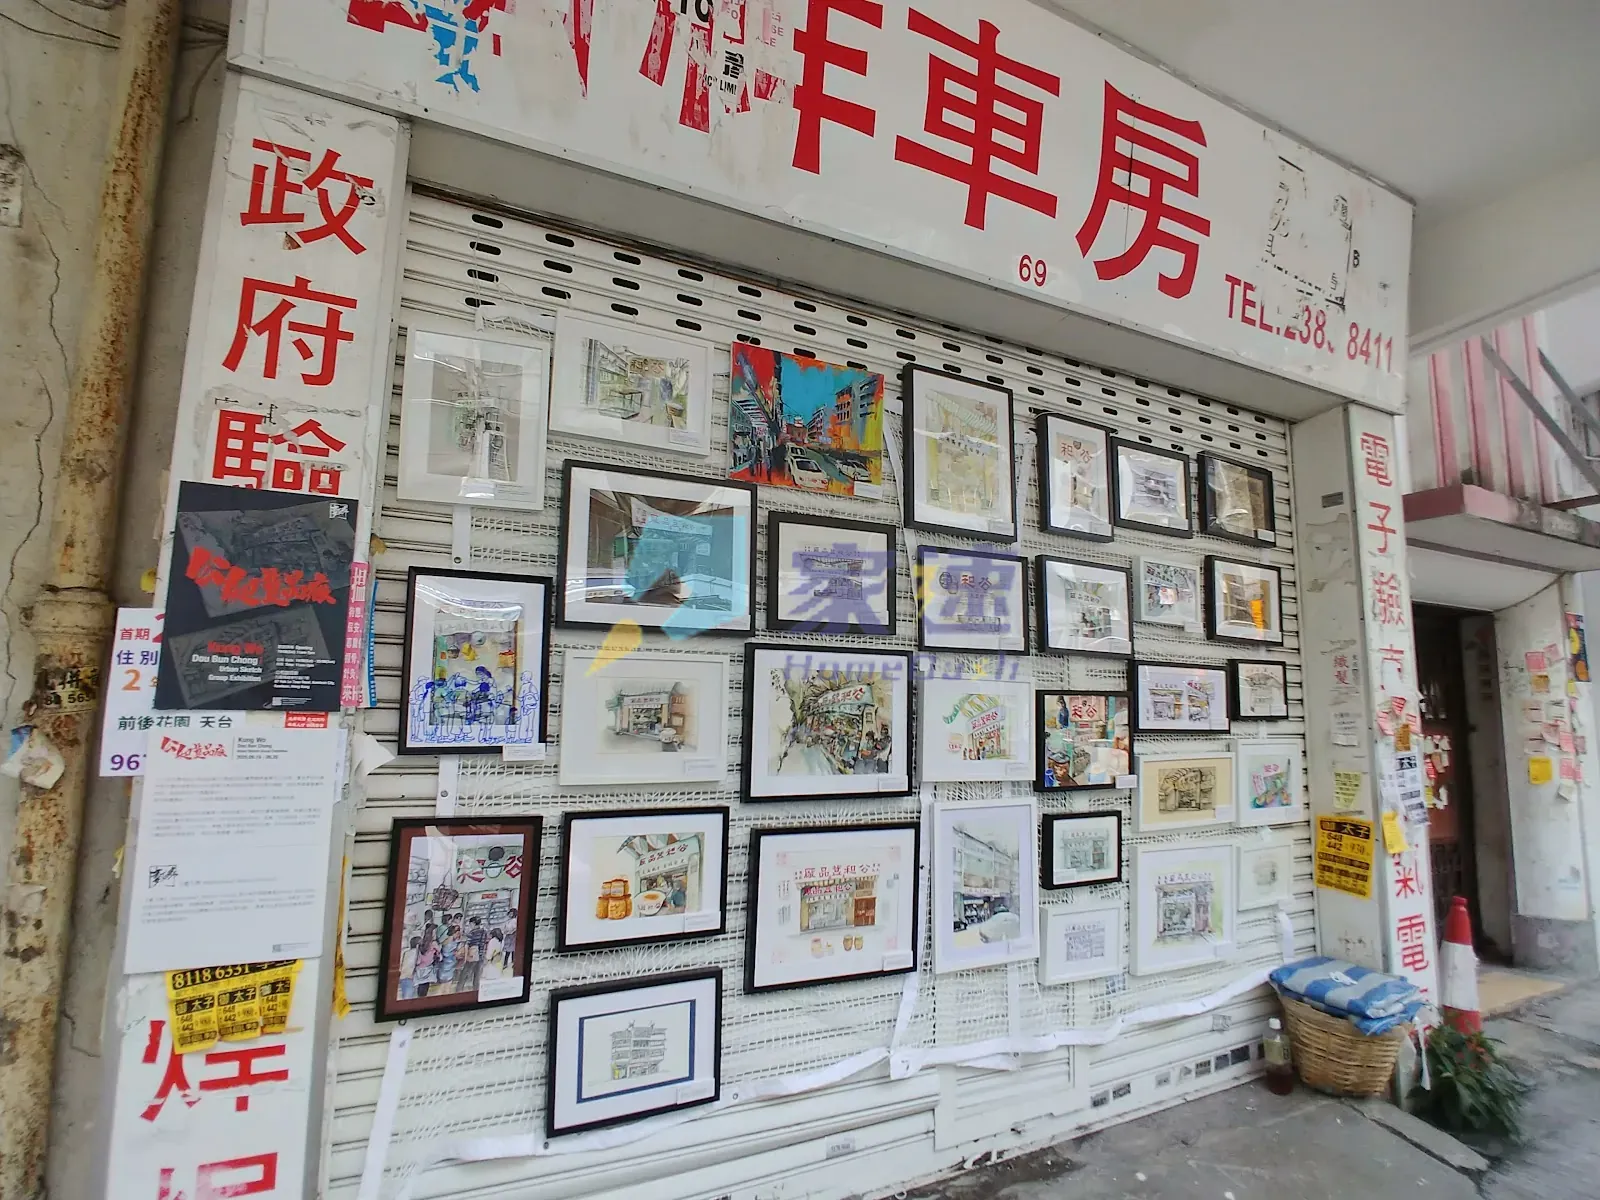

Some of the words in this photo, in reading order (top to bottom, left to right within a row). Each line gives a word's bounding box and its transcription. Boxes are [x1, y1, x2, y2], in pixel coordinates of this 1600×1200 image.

[1018, 254, 1047, 287] 69
[1347, 321, 1393, 373] 8411
[120, 629, 150, 641] 首期
[122, 669, 141, 691] 2
[117, 715, 191, 731] 前後花園
[200, 716, 233, 729] 天台
[110, 753, 147, 771] 96
[174, 968, 212, 989] 8118
